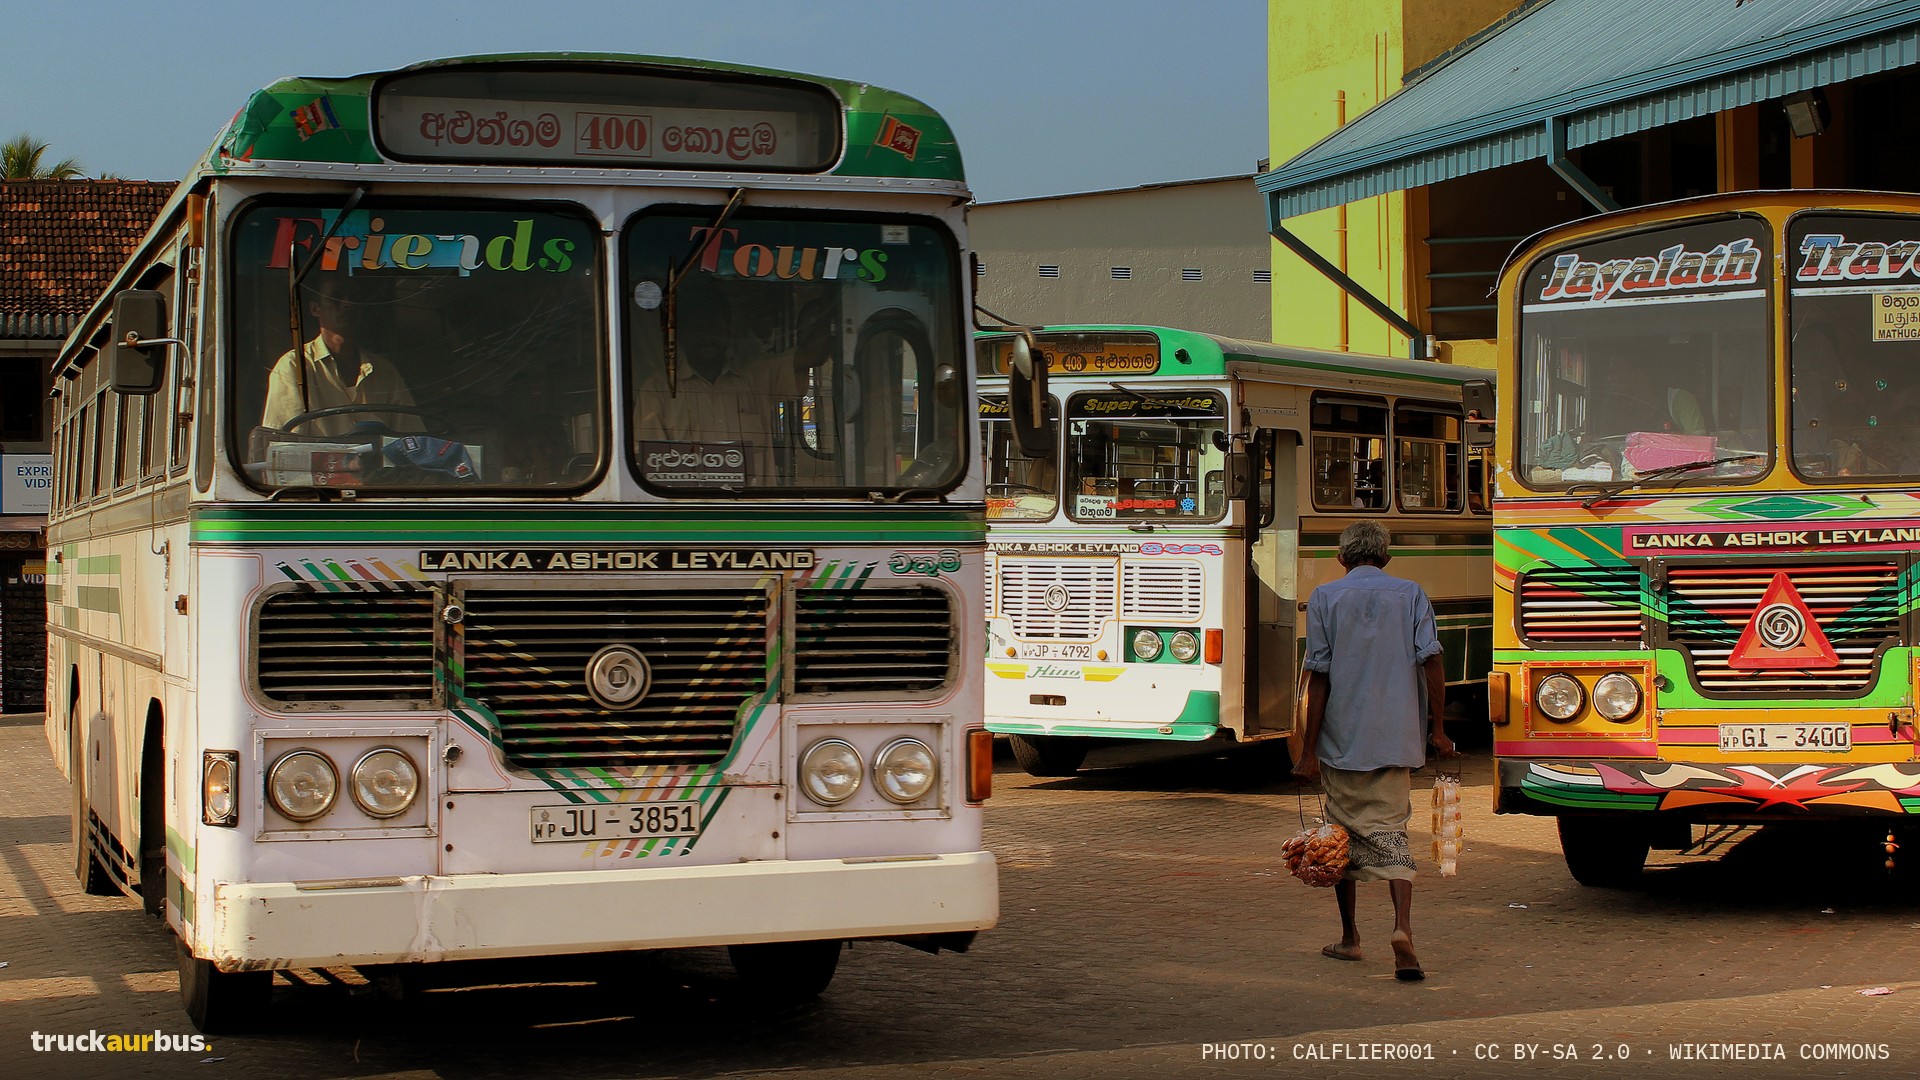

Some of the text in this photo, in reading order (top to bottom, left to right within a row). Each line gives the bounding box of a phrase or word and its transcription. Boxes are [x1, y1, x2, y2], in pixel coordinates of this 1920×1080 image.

[580, 115, 648, 152] 400
[661, 121, 777, 161] කොළඹ
[265, 216, 889, 284] Friends Tours
[1539, 233, 1920, 301] Jayalath Trav
[1884, 312, 1920, 329] மதுக
[1064, 355, 1082, 371] 408
[1083, 397, 1213, 414] Super Service
[17, 466, 52, 476] EXPR
[1080, 506, 1113, 518] මතුගම
[984, 543, 1023, 551] ANKA
[1027, 543, 1075, 551] ASHOK
[1078, 543, 1140, 553] LEYLAND
[1632, 534, 1714, 548] LANKA
[1723, 532, 1809, 546] ASHOK
[420, 551, 814, 570] LANKA ASHOK LEYLAND
[22, 573, 45, 584] VID
[1061, 645, 1090, 658] 4792
[1027, 665, 1080, 679] Hino
[1794, 727, 1847, 747] 3400
[628, 805, 695, 834] 3851
